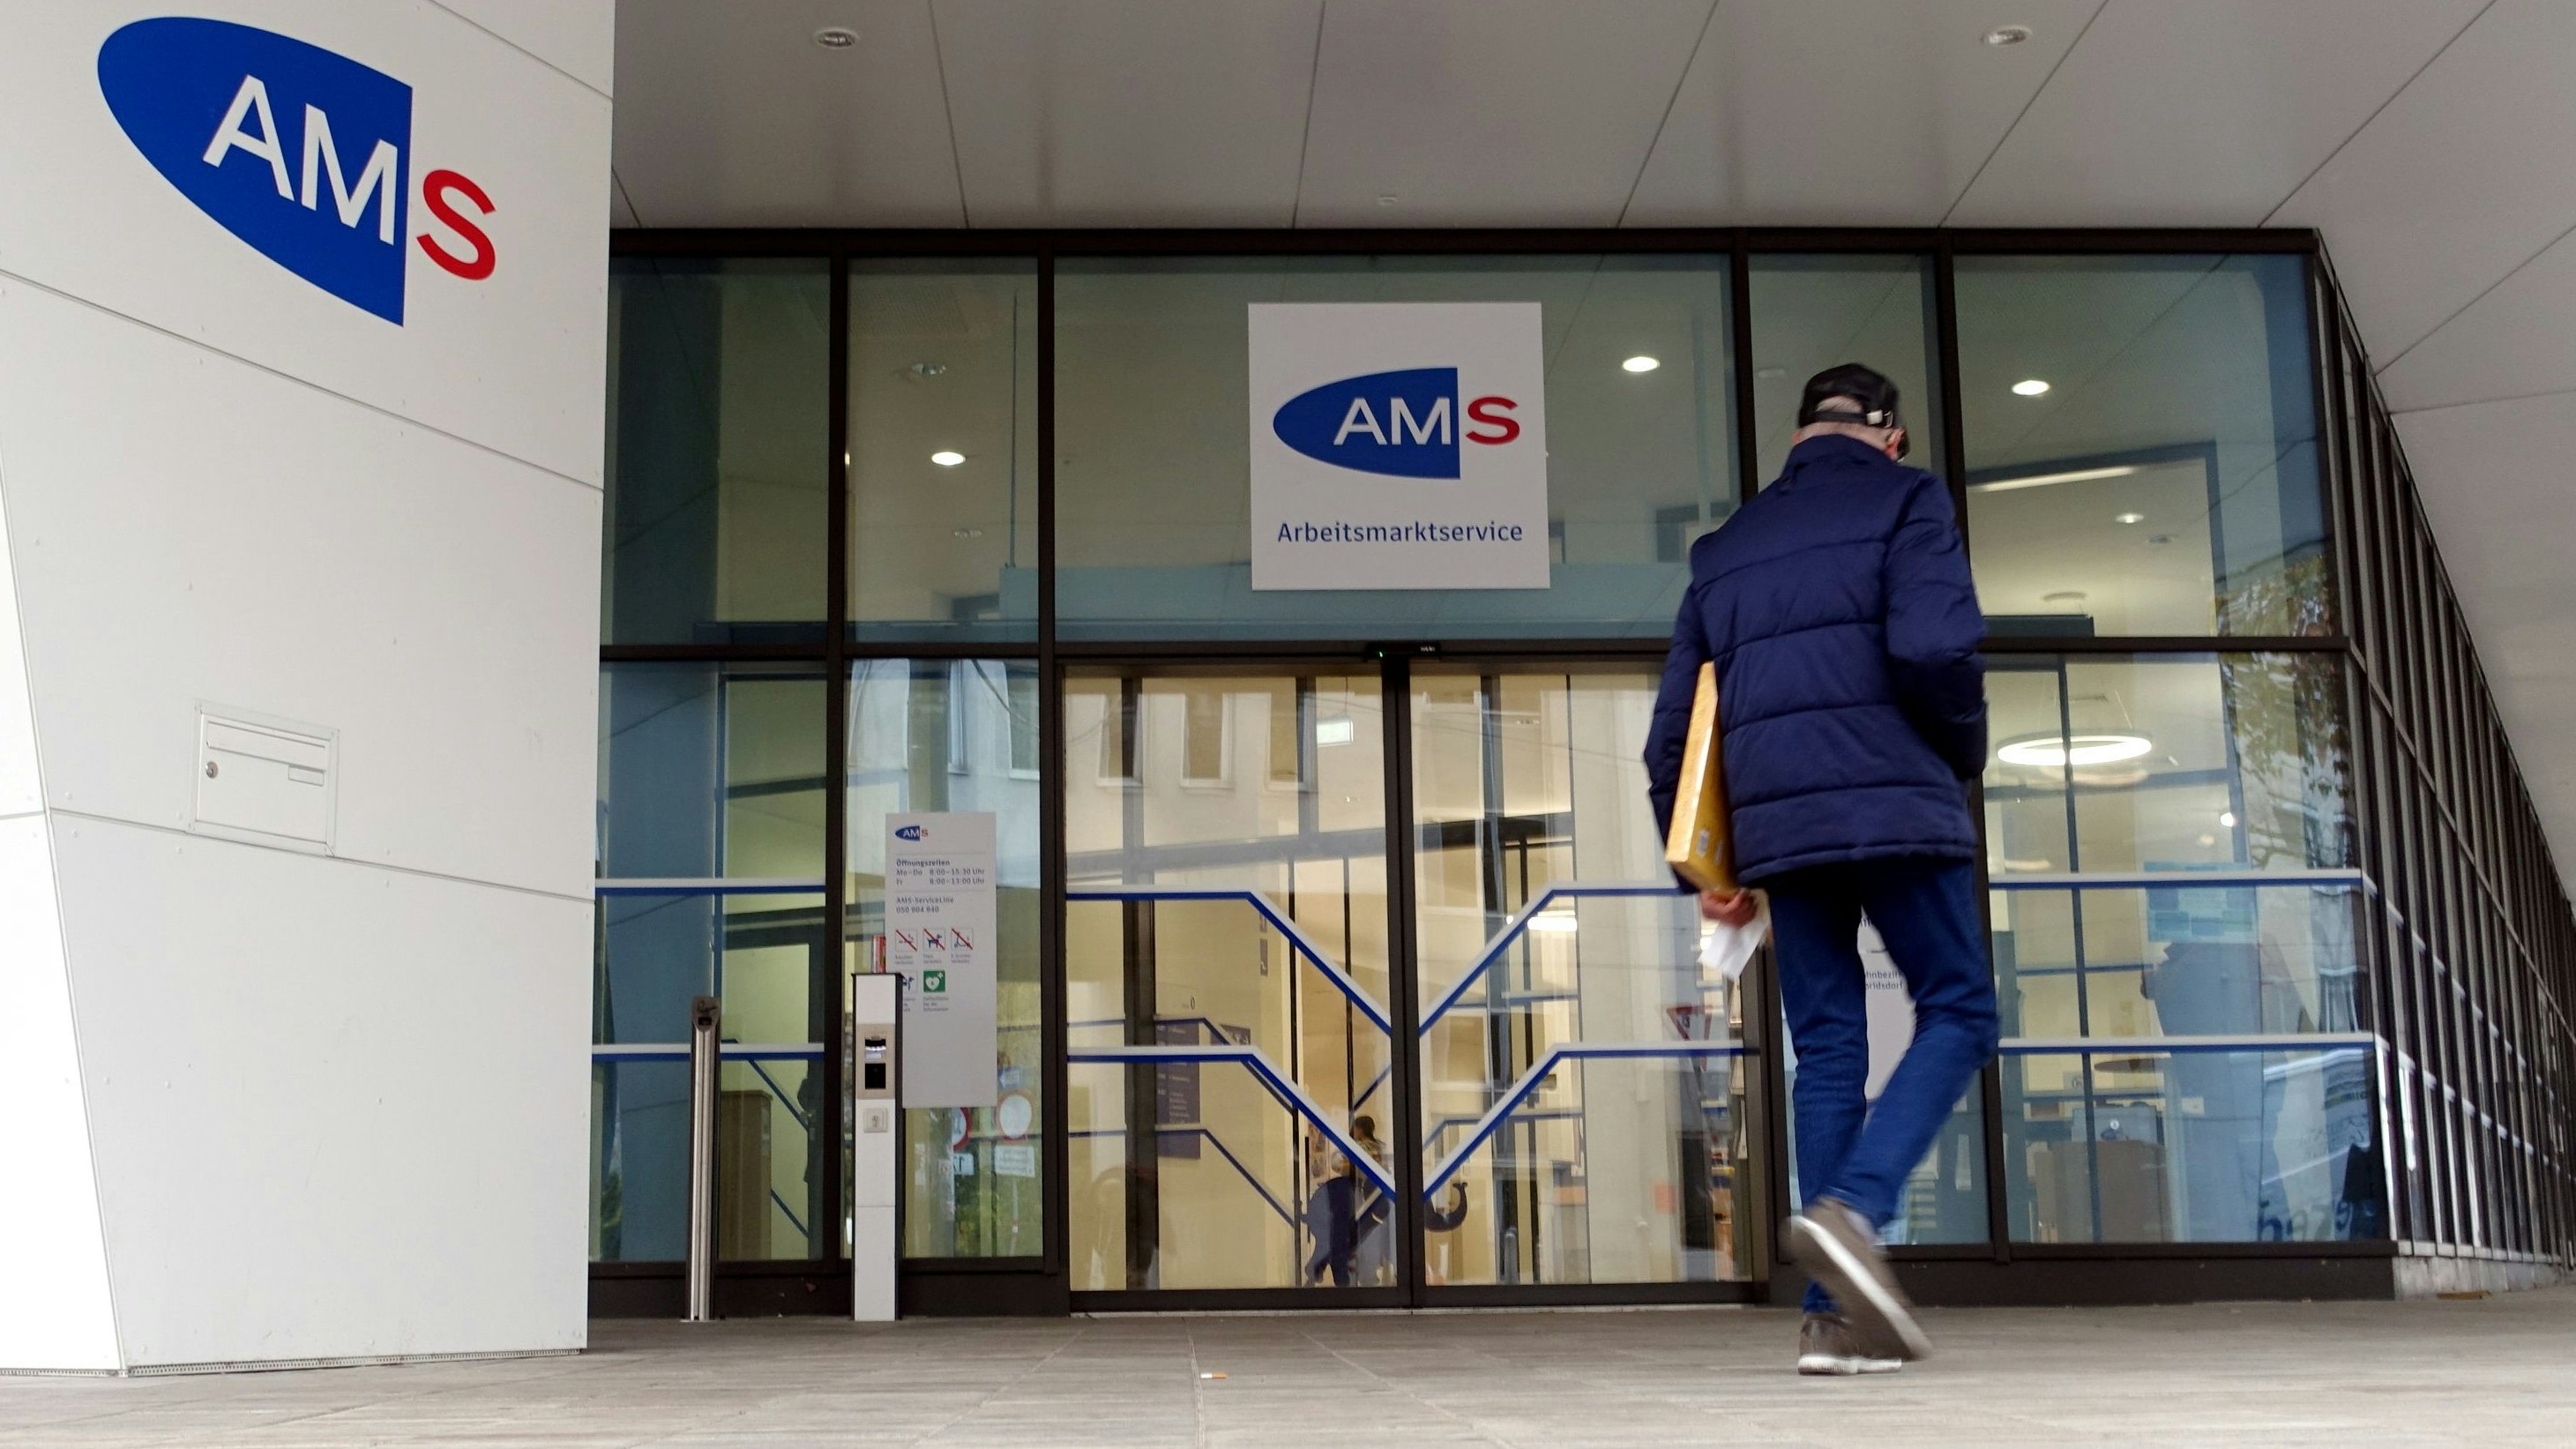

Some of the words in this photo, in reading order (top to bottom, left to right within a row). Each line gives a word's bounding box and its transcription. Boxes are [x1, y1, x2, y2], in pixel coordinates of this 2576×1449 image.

[203, 74, 496, 280] AMS
[1333, 395, 1520, 445] AMS
[1277, 520, 1523, 542] Arbeitsmarktservice
[902, 829, 929, 838] AMS
[896, 857, 951, 868] Öffnungszeiten
[972, 867, 985, 876] Uhr
[972, 877, 985, 885] Uhr
